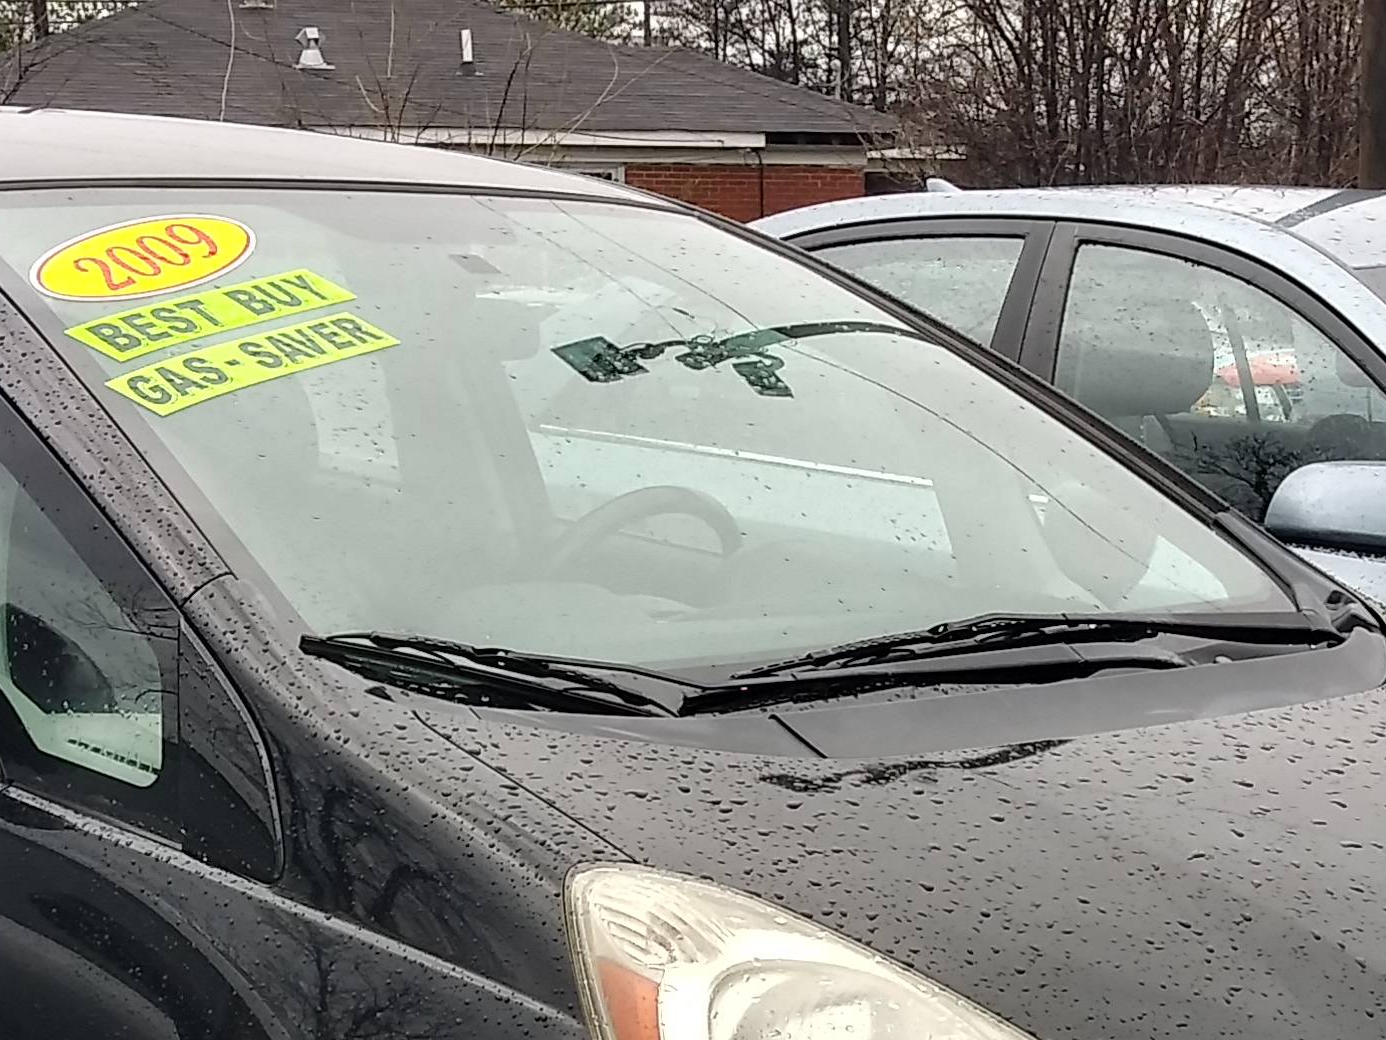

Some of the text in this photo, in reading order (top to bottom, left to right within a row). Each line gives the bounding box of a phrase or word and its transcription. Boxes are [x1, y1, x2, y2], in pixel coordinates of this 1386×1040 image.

[74, 223, 219, 291] 2009
[85, 274, 328, 353] BEST BUY
